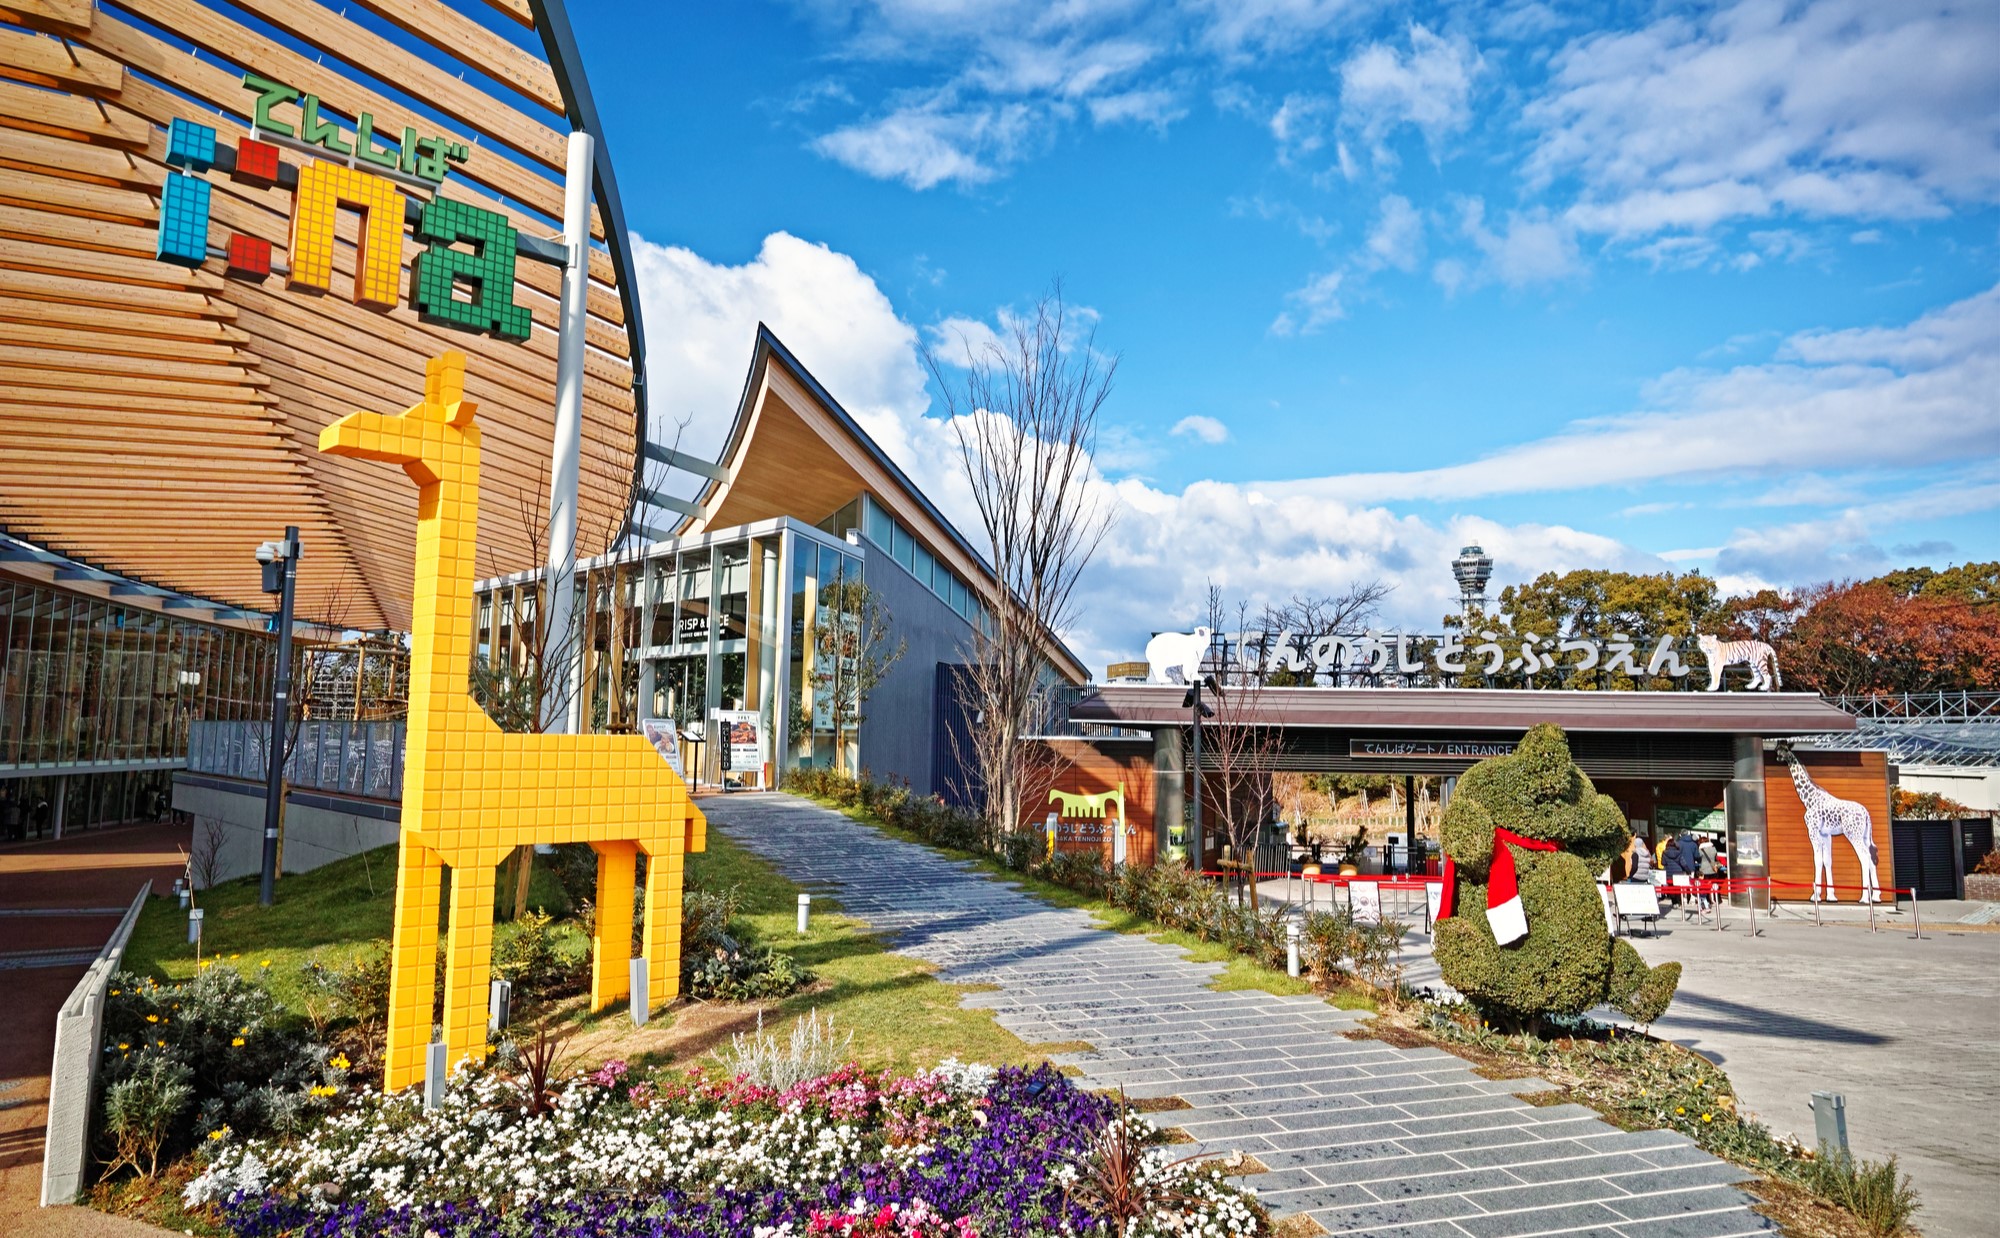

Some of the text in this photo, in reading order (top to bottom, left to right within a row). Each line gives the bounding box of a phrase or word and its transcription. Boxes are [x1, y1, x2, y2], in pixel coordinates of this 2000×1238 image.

[242, 73, 470, 184] てんしば
[1223, 629, 1691, 678] てんのうじどうぶつえん
[1364, 743, 1435, 755] てんしばゲート
[1447, 744, 1513, 756] ENTRANCE
